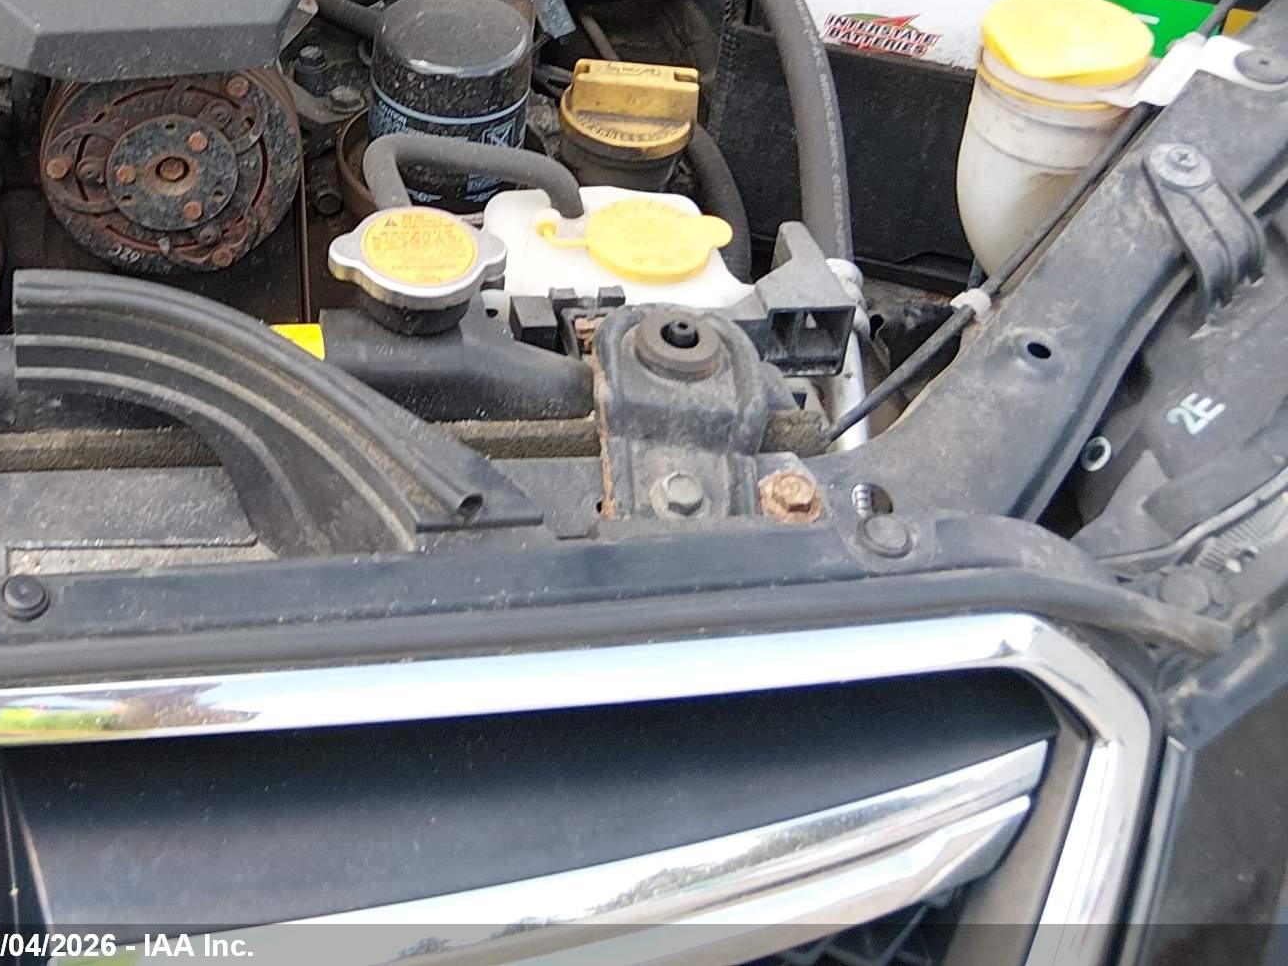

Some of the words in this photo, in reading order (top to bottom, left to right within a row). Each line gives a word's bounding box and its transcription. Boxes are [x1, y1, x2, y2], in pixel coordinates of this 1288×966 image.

[825, 13, 940, 45] INTERSTATE
[825, 26, 927, 55] BATTERIES
[1166, 392, 1226, 435] 2E
